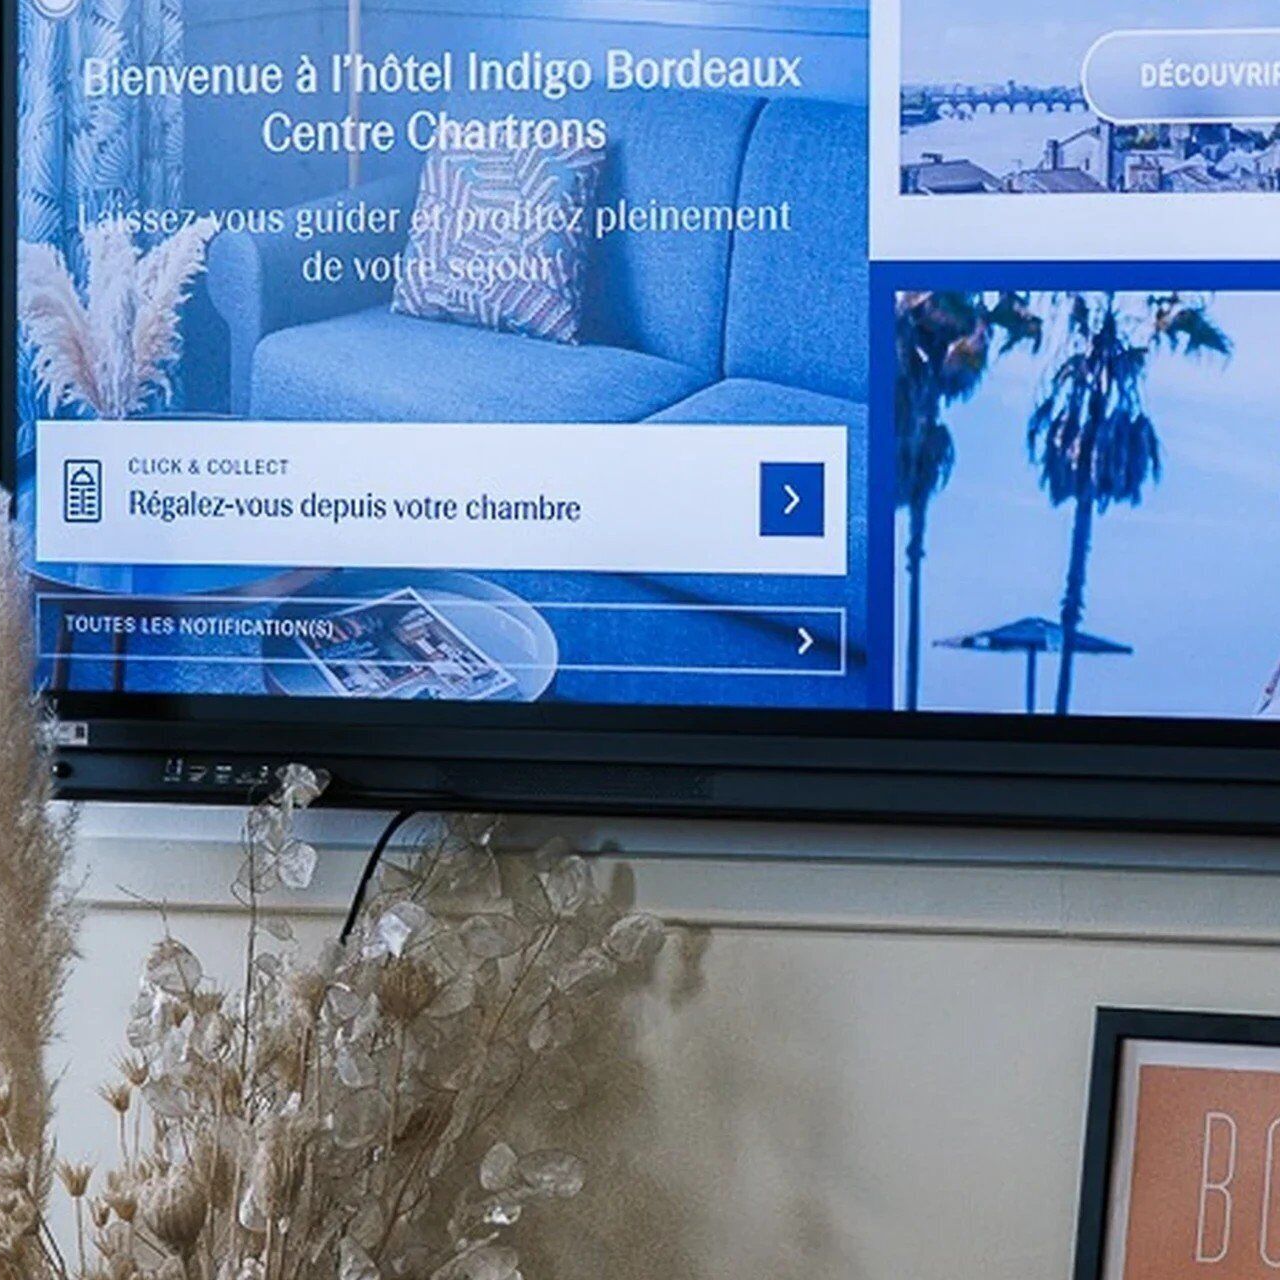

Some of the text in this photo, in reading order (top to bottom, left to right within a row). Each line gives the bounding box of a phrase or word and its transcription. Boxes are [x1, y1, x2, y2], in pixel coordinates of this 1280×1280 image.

[83, 57, 284, 98] Bienvenue
[295, 53, 318, 95] à
[467, 51, 592, 99] Indigo
[606, 47, 802, 92] Bordeaux
[262, 110, 607, 154] Centre Chartrons
[78, 198, 792, 239] Laissezvous guider et profitez pleinement
[301, 251, 344, 283] de
[353, 254, 435, 282] votre
[128, 457, 289, 477] CLICK & COLLECT
[128, 489, 581, 524] Régalez-vous depuis votre chambre
[64, 614, 333, 640] TOUTES LES NOTIFICATION(S)
